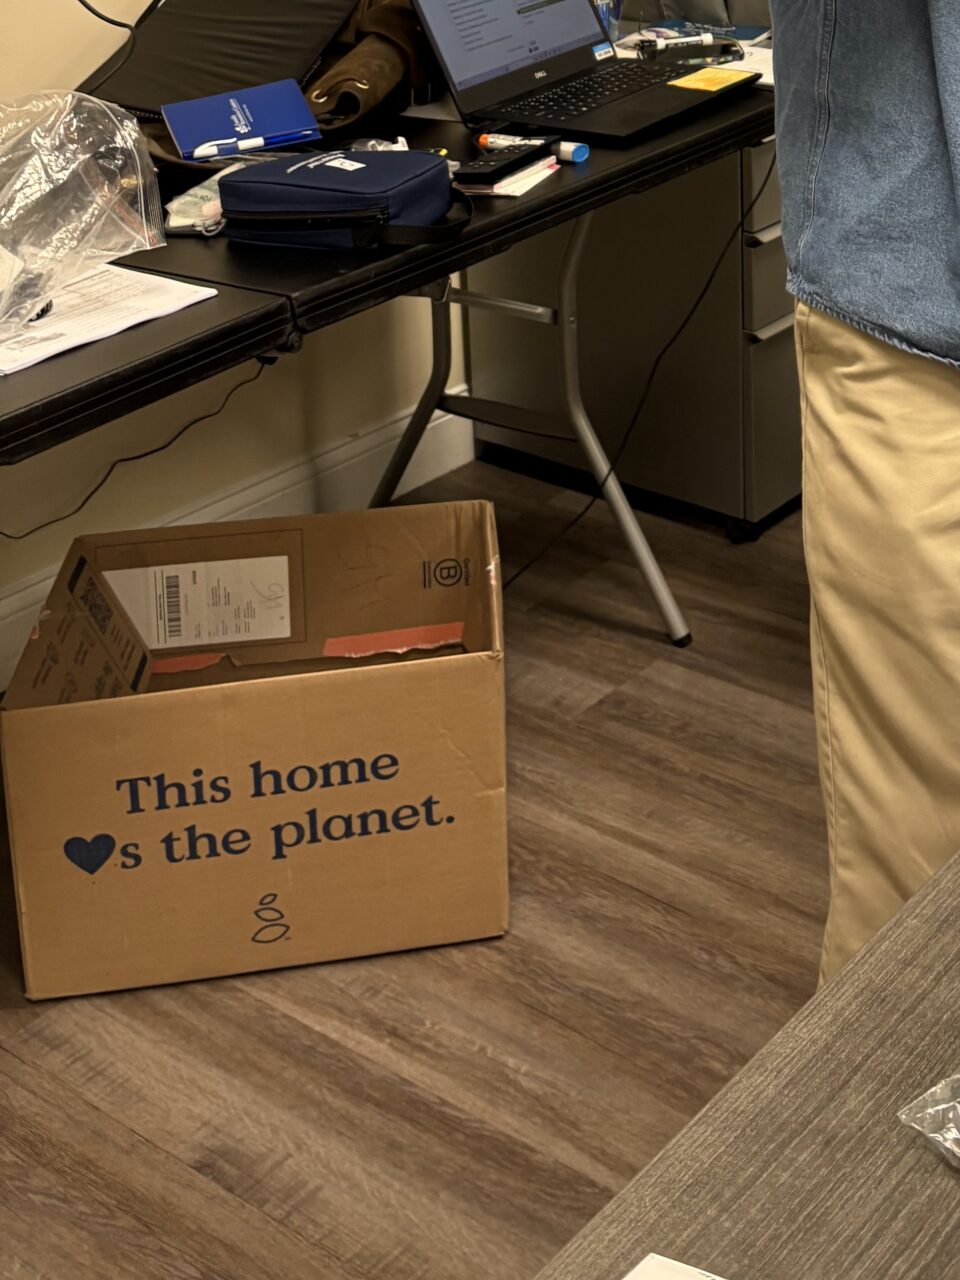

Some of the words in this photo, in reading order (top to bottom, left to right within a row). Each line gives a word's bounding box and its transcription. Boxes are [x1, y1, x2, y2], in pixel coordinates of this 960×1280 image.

[115, 768, 232, 814] This
[249, 752, 400, 799] home
[161, 825, 251, 864] the
[271, 794, 455, 860] planet.
